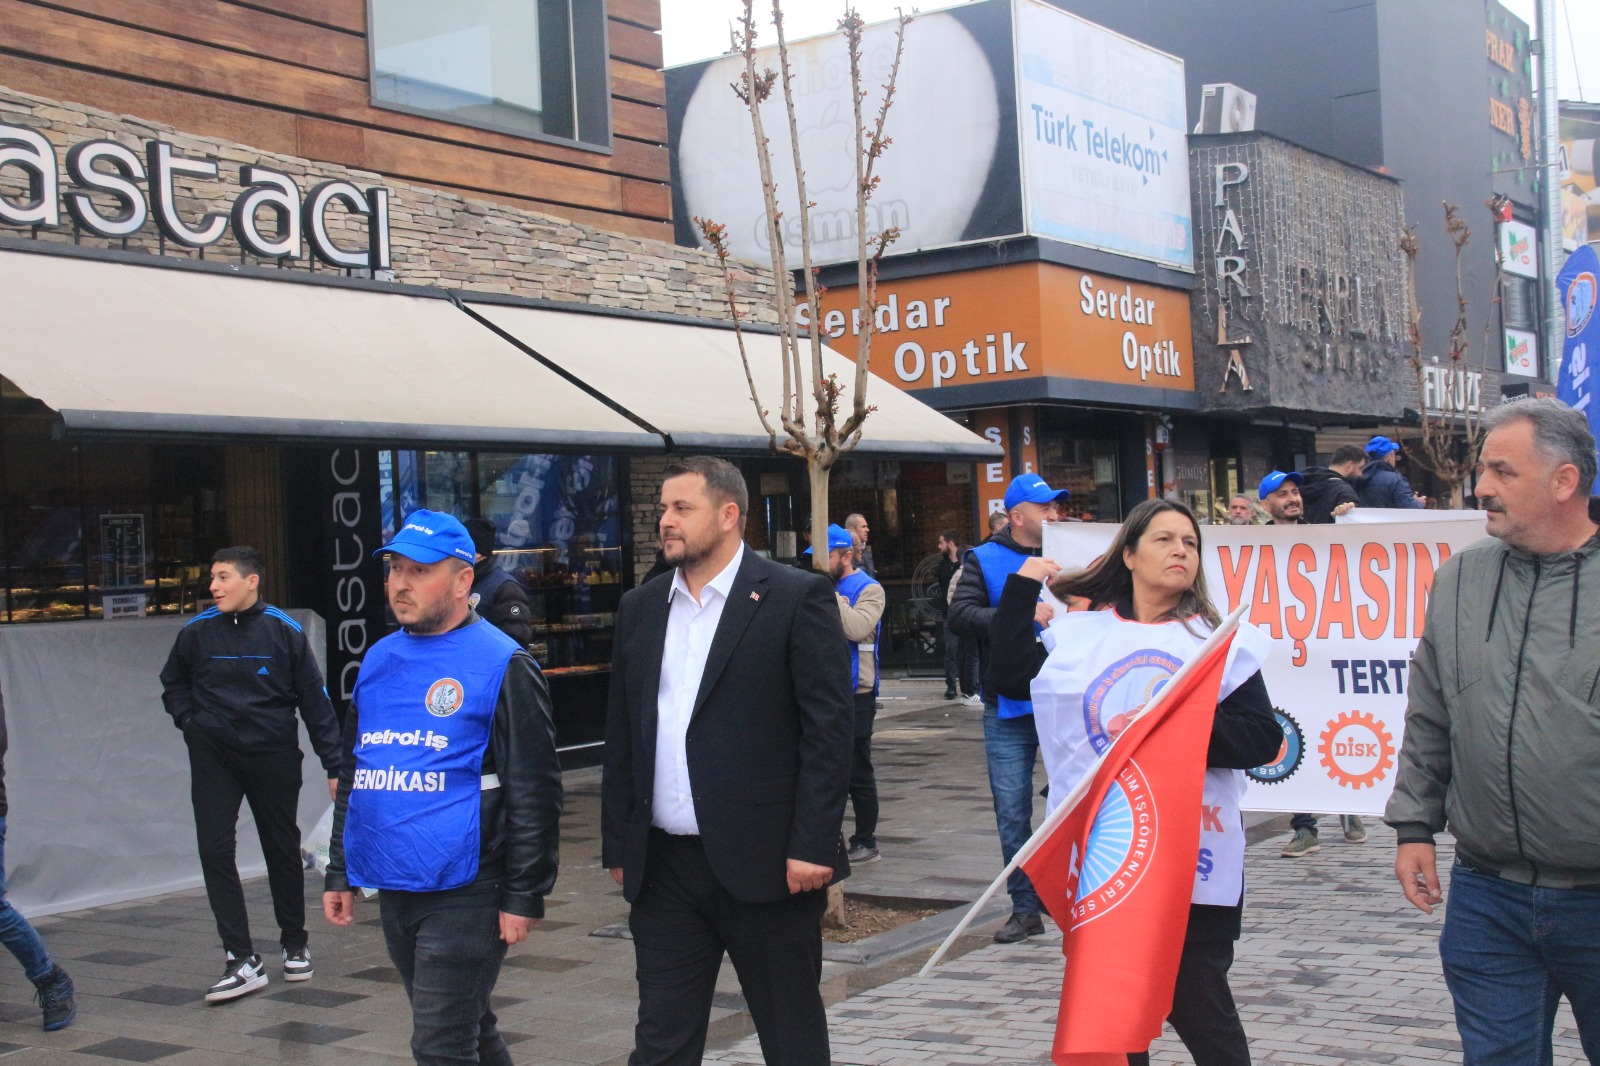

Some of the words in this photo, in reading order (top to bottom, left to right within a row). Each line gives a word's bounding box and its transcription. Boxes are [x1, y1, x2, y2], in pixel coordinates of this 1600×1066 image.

[1031, 103, 1078, 152] Türk
[1082, 118, 1161, 176] Telekom
[0, 122, 392, 270] astacı
[1079, 275, 1155, 326] Serdar
[1214, 162, 1254, 393] PARLA
[794, 293, 951, 339] Serdar
[894, 331, 1029, 389] Optik
[1122, 331, 1181, 382] Optik
[331, 449, 367, 700] pastac
[1217, 542, 1451, 667] YAŞASIN
[361, 729, 448, 751] petrol-iş
[1335, 736, 1377, 757] DİSK
[353, 765, 446, 792] SENDİKASI
[1119, 767, 1140, 793] LİM
[1253, 764, 1285, 775] 952
[1070, 899, 1096, 922] SEN
